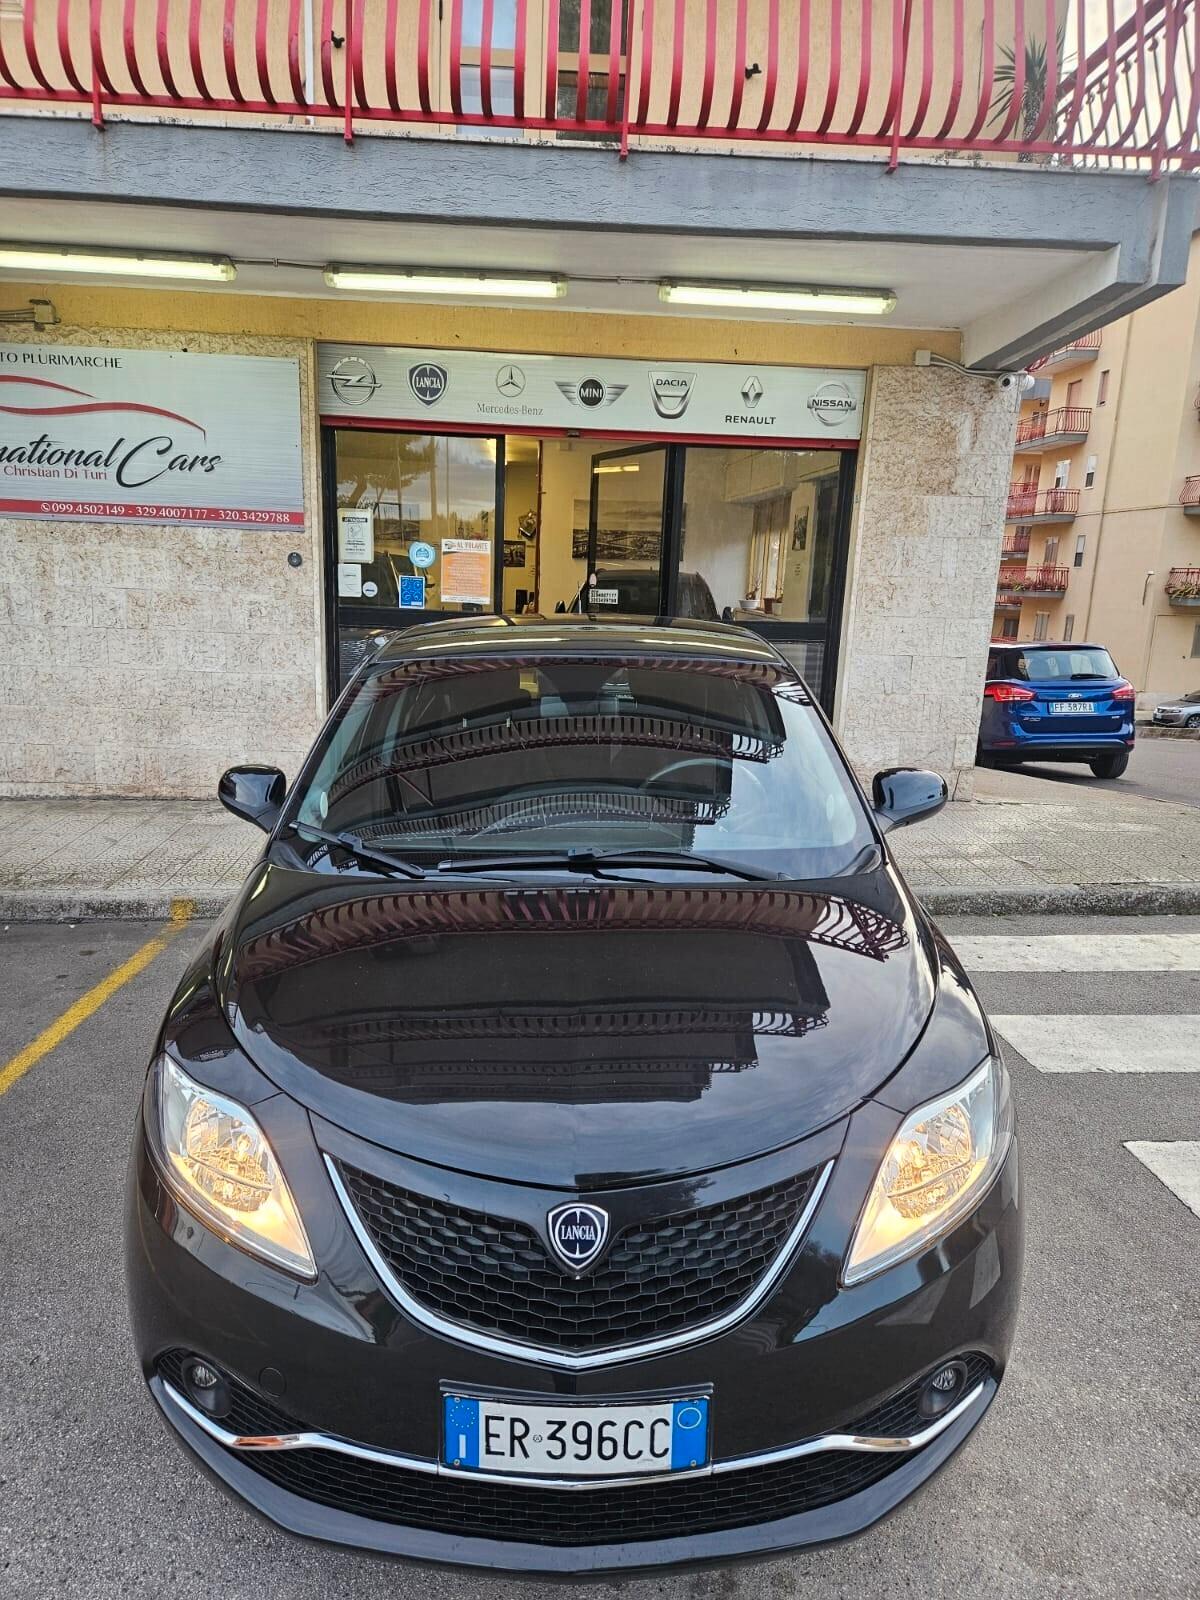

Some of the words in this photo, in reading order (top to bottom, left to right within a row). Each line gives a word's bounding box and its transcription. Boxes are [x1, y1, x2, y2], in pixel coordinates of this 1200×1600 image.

[22, 353, 123, 369] PLURIMARCHE
[415, 376, 442, 389] LANCIA
[656, 378, 688, 388] DACIA
[580, 387, 603, 399] MINI
[476, 402, 544, 416] Mercedes-Benz
[811, 398, 853, 408] NISSAN
[725, 415, 776, 425] RENAULT
[116, 436, 224, 488] Cars
[4, 465, 60, 478] Christian
[64, 468, 78, 479] Di
[81, 468, 107, 480] Turi
[51, 502, 125, 515] 099.4502149
[135, 506, 208, 519] 329.4007177
[218, 510, 290, 523] 320.3429788
[561, 1224, 596, 1241] LANCIA
[484, 1415, 531, 1459] ER
[545, 1417, 670, 1460] 396CC
